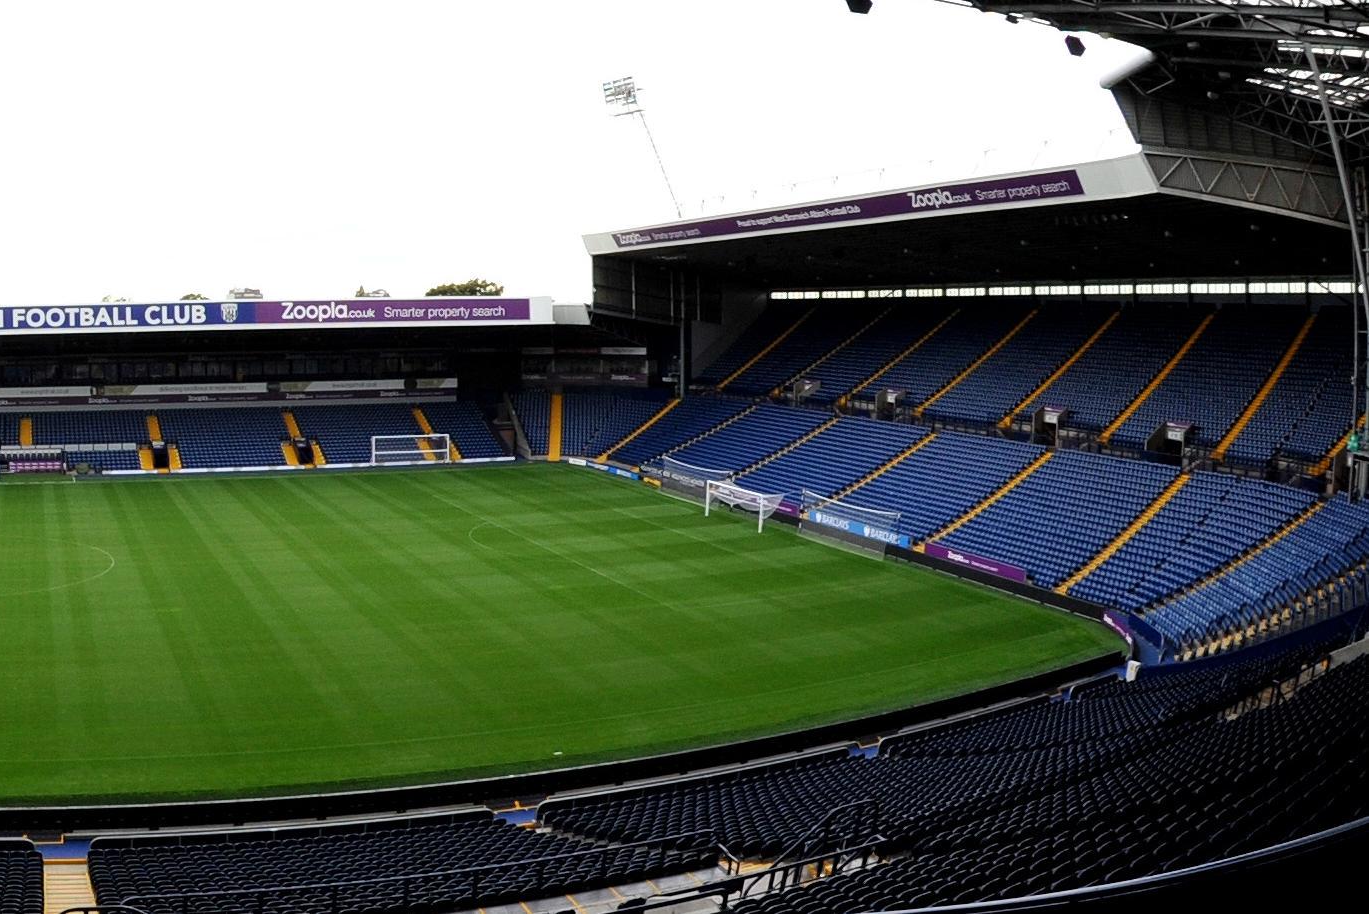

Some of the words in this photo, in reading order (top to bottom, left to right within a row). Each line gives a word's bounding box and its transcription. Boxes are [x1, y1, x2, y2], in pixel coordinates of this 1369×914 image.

[906, 188, 972, 208] Zoopla.co.uk
[975, 189, 1006, 201] Smarter
[1007, 185, 1041, 199] property
[1042, 180, 1070, 194] search
[12, 306, 138, 328] FOOTBALL
[144, 304, 206, 325] CLUB
[280, 301, 376, 322] Zoopla.co.uk
[383, 306, 426, 319] Smarter
[427, 305, 471, 320] property
[472, 305, 506, 317] search
[822, 513, 850, 531] BARCLAYS
